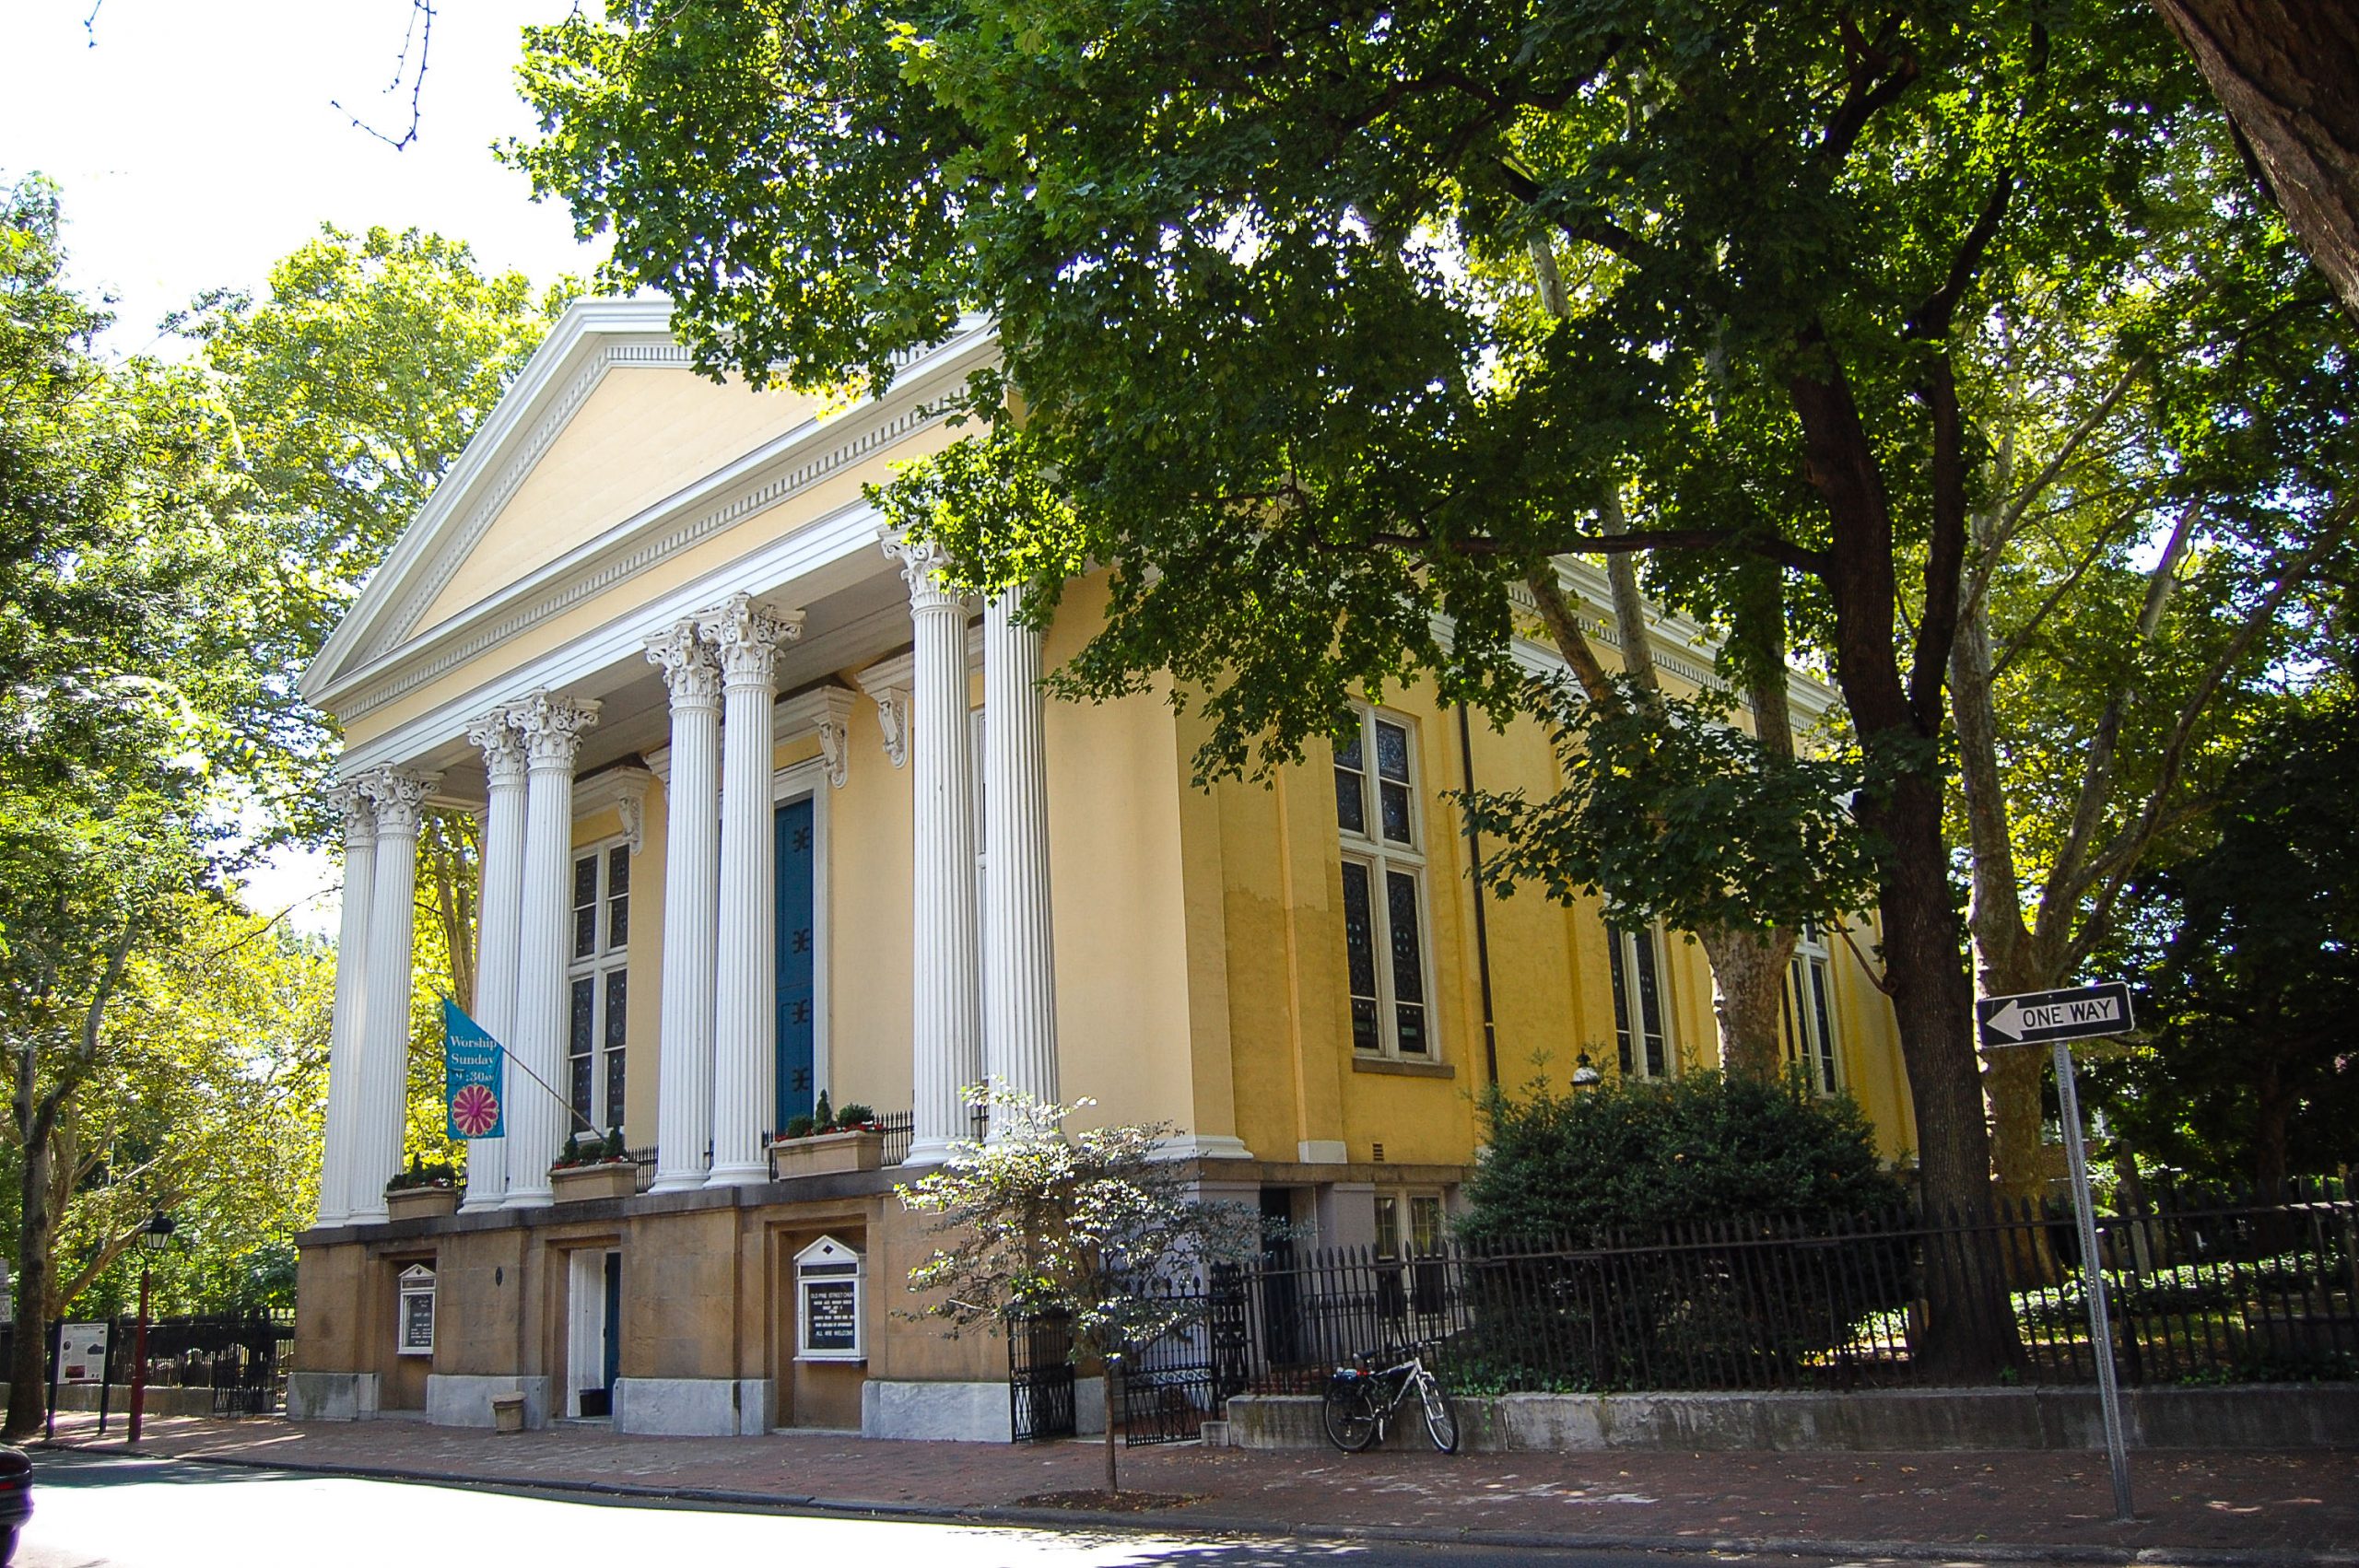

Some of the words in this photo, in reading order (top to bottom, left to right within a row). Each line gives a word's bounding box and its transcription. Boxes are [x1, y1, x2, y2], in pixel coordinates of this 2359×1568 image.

[2023, 1006, 2064, 1028] ONE
[2069, 999, 2111, 1023] WAY
[450, 1036, 497, 1050] Worship
[452, 1053, 494, 1069] Sunday
